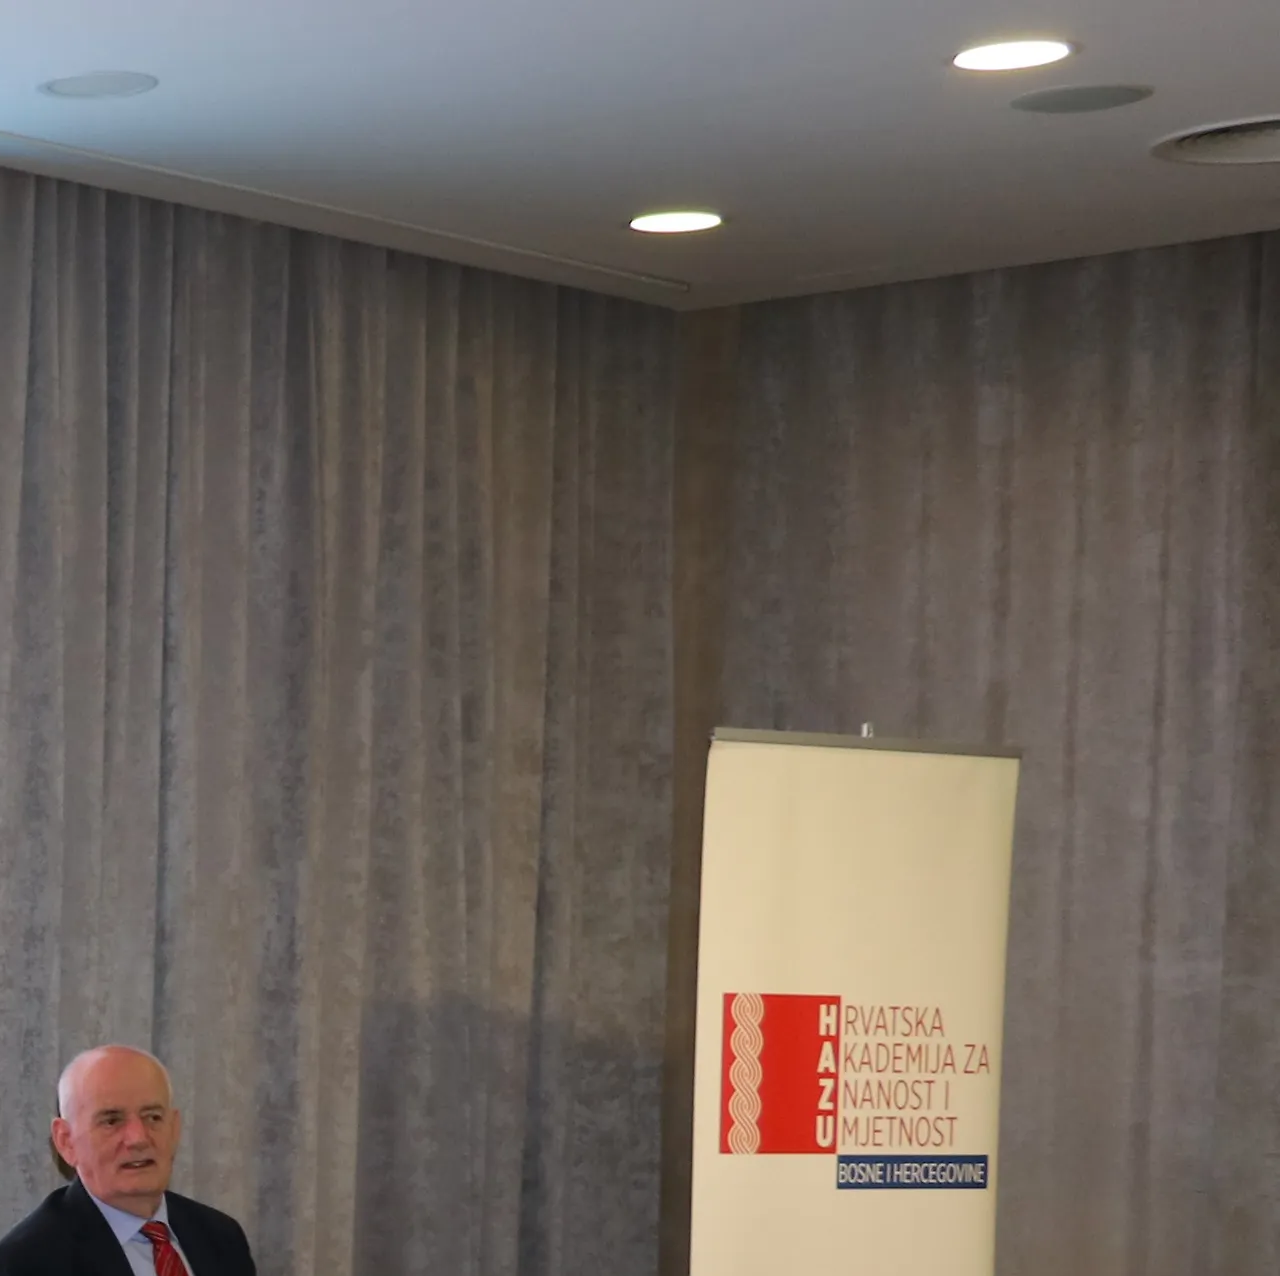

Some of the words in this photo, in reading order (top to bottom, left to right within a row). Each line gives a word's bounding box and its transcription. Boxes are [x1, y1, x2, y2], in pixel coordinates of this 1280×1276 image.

[963, 1043, 990, 1074] ZA
[843, 1079, 936, 1110] NANOST
[944, 1080, 950, 1111] I
[841, 1115, 958, 1147] MJETNOST
[838, 1162, 884, 1184] BOSNE
[886, 1163, 891, 1184] I
[893, 1162, 985, 1184] HERCEGOVINE
